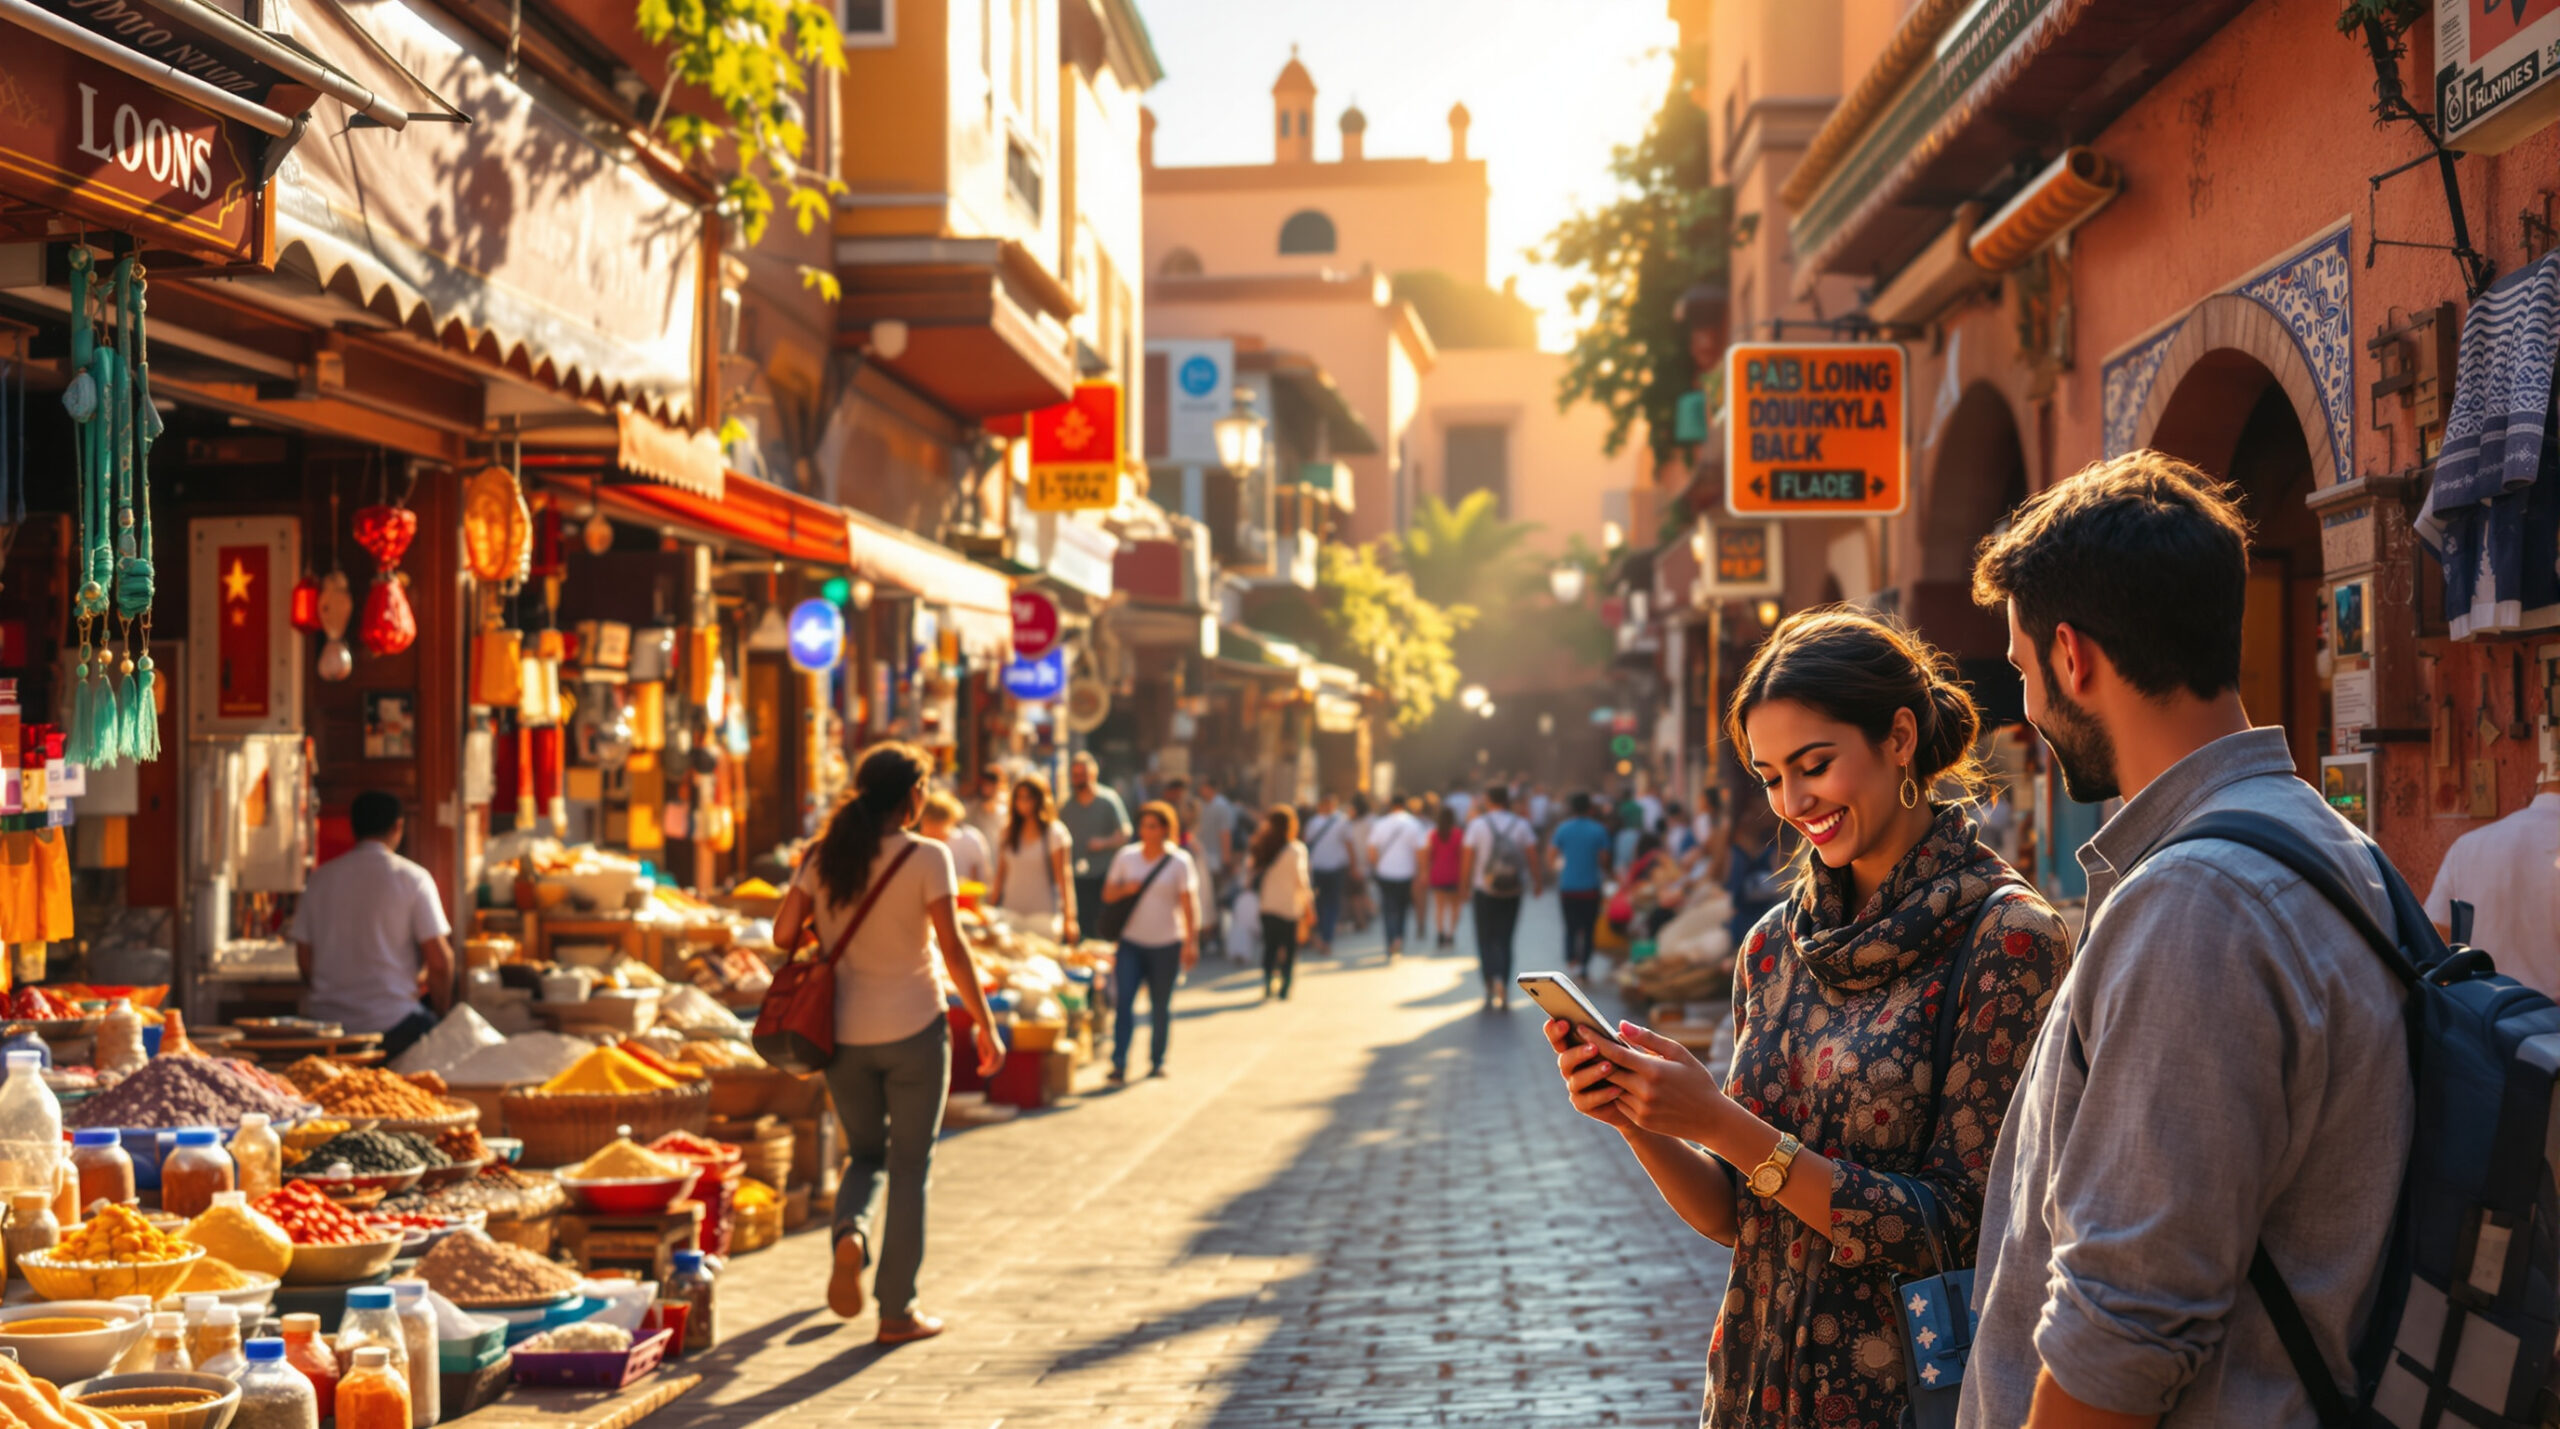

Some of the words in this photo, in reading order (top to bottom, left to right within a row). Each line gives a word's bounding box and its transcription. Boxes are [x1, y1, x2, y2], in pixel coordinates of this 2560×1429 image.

[77, 82, 212, 200] LOONS
[1809, 361, 1892, 393] LOING
[1751, 433, 1823, 462] BALK
